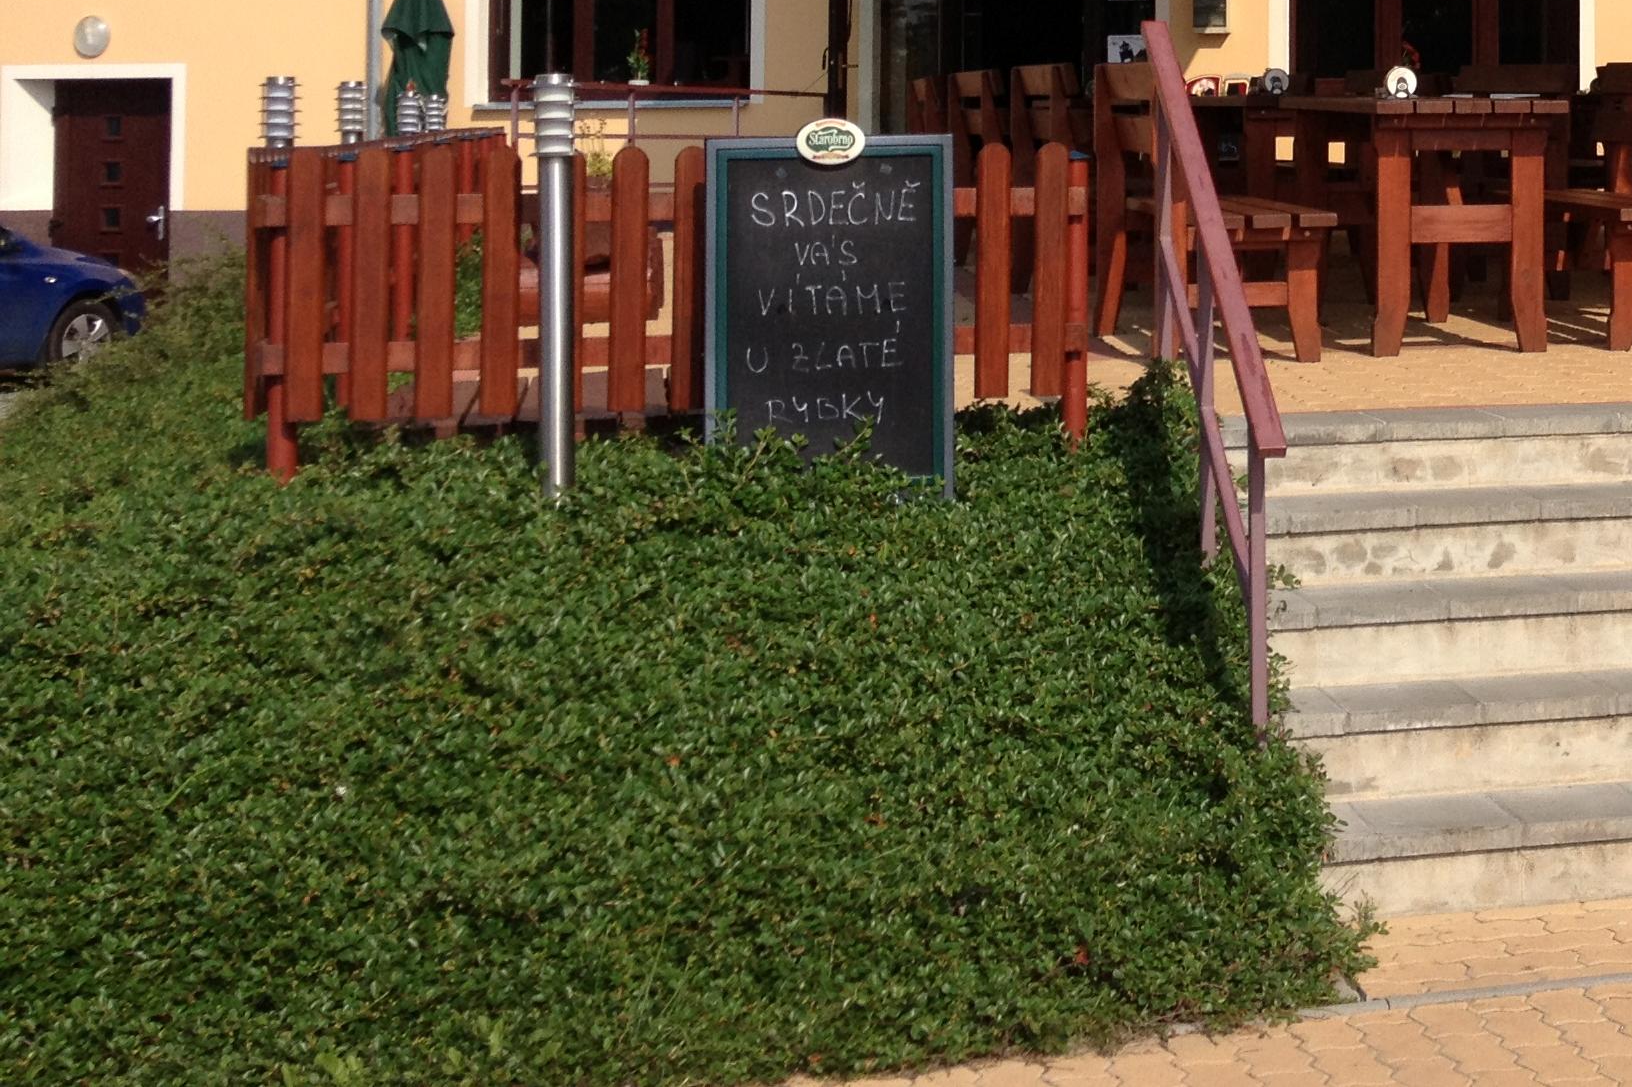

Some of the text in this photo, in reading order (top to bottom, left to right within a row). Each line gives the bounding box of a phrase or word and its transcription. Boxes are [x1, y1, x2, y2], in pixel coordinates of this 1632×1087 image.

[808, 129, 854, 152] Starobrno
[751, 180, 921, 227] SRDEČNĚ
[794, 234, 858, 266] VÁS
[757, 269, 907, 316] VÍTÁME
[746, 320, 904, 373] U ZLATÉ
[765, 391, 885, 425] RYBKY
